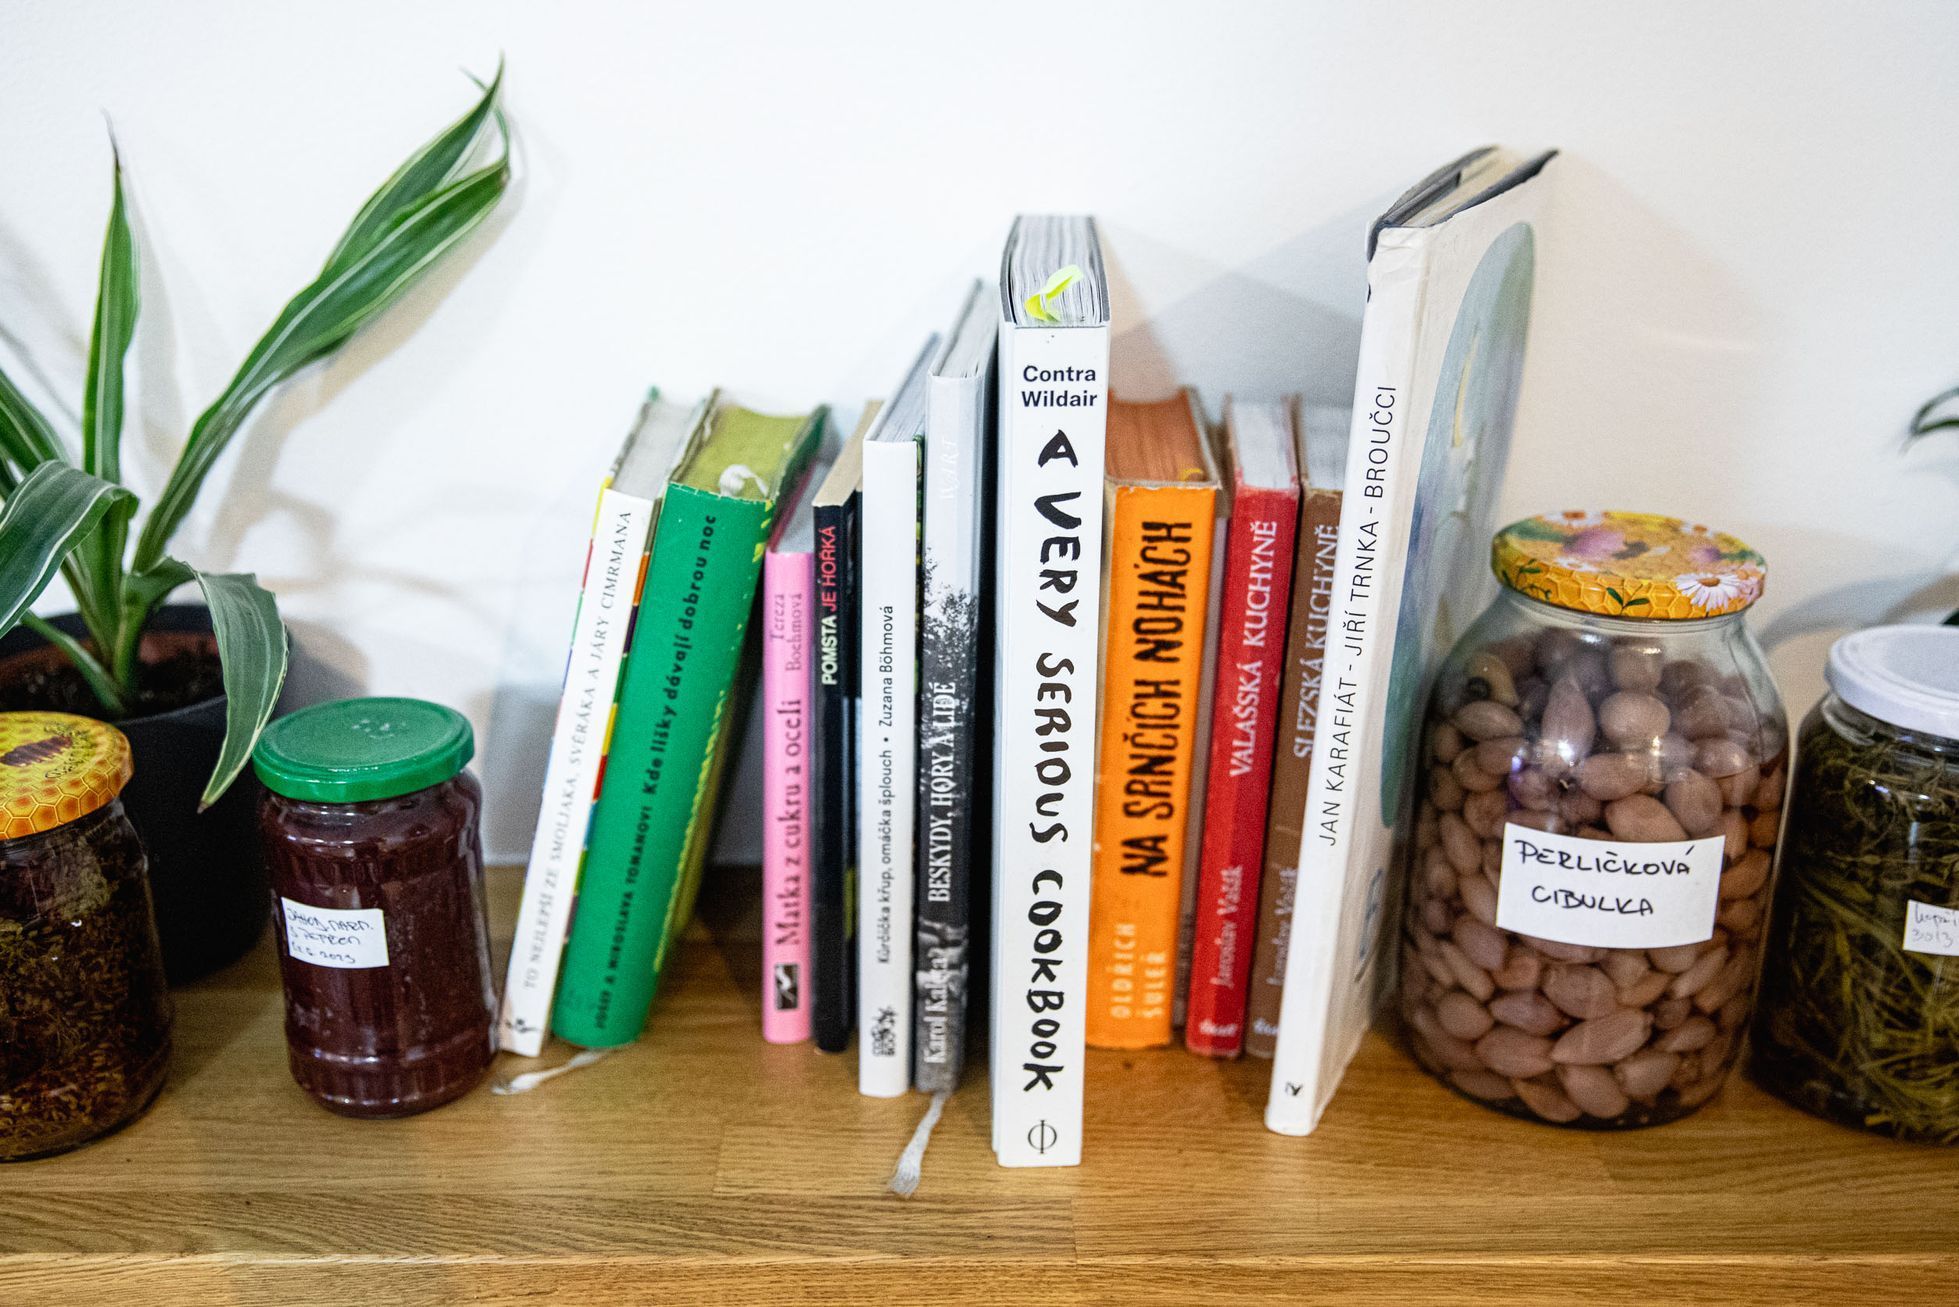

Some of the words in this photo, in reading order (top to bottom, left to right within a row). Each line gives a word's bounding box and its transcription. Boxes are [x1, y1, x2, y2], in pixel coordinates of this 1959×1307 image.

[1021, 390, 1098, 409] Wildair
[1022, 364, 1097, 383] Contra
[1038, 429, 1079, 468] A
[1363, 386, 1397, 499] BROUČCI
[600, 511, 632, 610] CIMRMANA
[700, 514, 717, 553] noc
[818, 525, 836, 587] HOŘKÁ
[1034, 491, 1082, 627] VERY
[1350, 520, 1379, 602] TRNKA
[679, 555, 708, 631] dobrou
[822, 591, 837, 612] JE
[1132, 521, 1193, 663] NOHÁCH
[1244, 520, 1277, 649] KUCHYNĚ
[1305, 524, 1340, 650] KUCHYNĚ
[589, 617, 610, 661] JÁRY
[770, 594, 786, 641] Tereza
[785, 593, 803, 672] Boehmová
[879, 604, 894, 673] Böhmová
[1342, 610, 1367, 657] JIŘÍ
[587, 667, 600, 680] A
[663, 635, 693, 700] dávají
[822, 615, 838, 686] POMSTA
[568, 688, 595, 766] SVĚRÁKA
[651, 704, 677, 752] lišky
[776, 698, 803, 757] oceli
[879, 677, 893, 727] Zuzana
[928, 681, 957, 728] LIDÉ
[1230, 659, 1263, 778] VALAŠSKÁ
[931, 733, 955, 748] A
[1029, 651, 1076, 844] SERIOUS
[1122, 679, 1182, 821] SRNČÍCH
[1326, 676, 1358, 791] KARAFIÁT
[642, 754, 660, 796] Kde
[786, 767, 802, 783] a
[878, 749, 895, 804] šplouch
[930, 751, 957, 806] HORY
[777, 783, 802, 851] cukru
[877, 810, 892, 864] omáčka
[1319, 800, 1341, 847] JAN
[543, 868, 559, 888] ZE
[784, 855, 801, 872] z
[928, 811, 955, 902] BESKYDY,
[1120, 834, 1169, 878] NA
[1514, 839, 1696, 876] PERLIČKOVÁ
[608, 891, 634, 970] MIROSLAVA
[625, 806, 653, 885] TOMANOVI
[774, 873, 801, 948] Matka
[877, 867, 894, 904] křup,
[1531, 885, 1655, 917] CIBULKA
[529, 892, 553, 964] NEJLEPŠÍ
[523, 969, 540, 990] TO
[1023, 869, 1065, 1093] COOKBOOK
[924, 1015, 948, 1064] Karol
